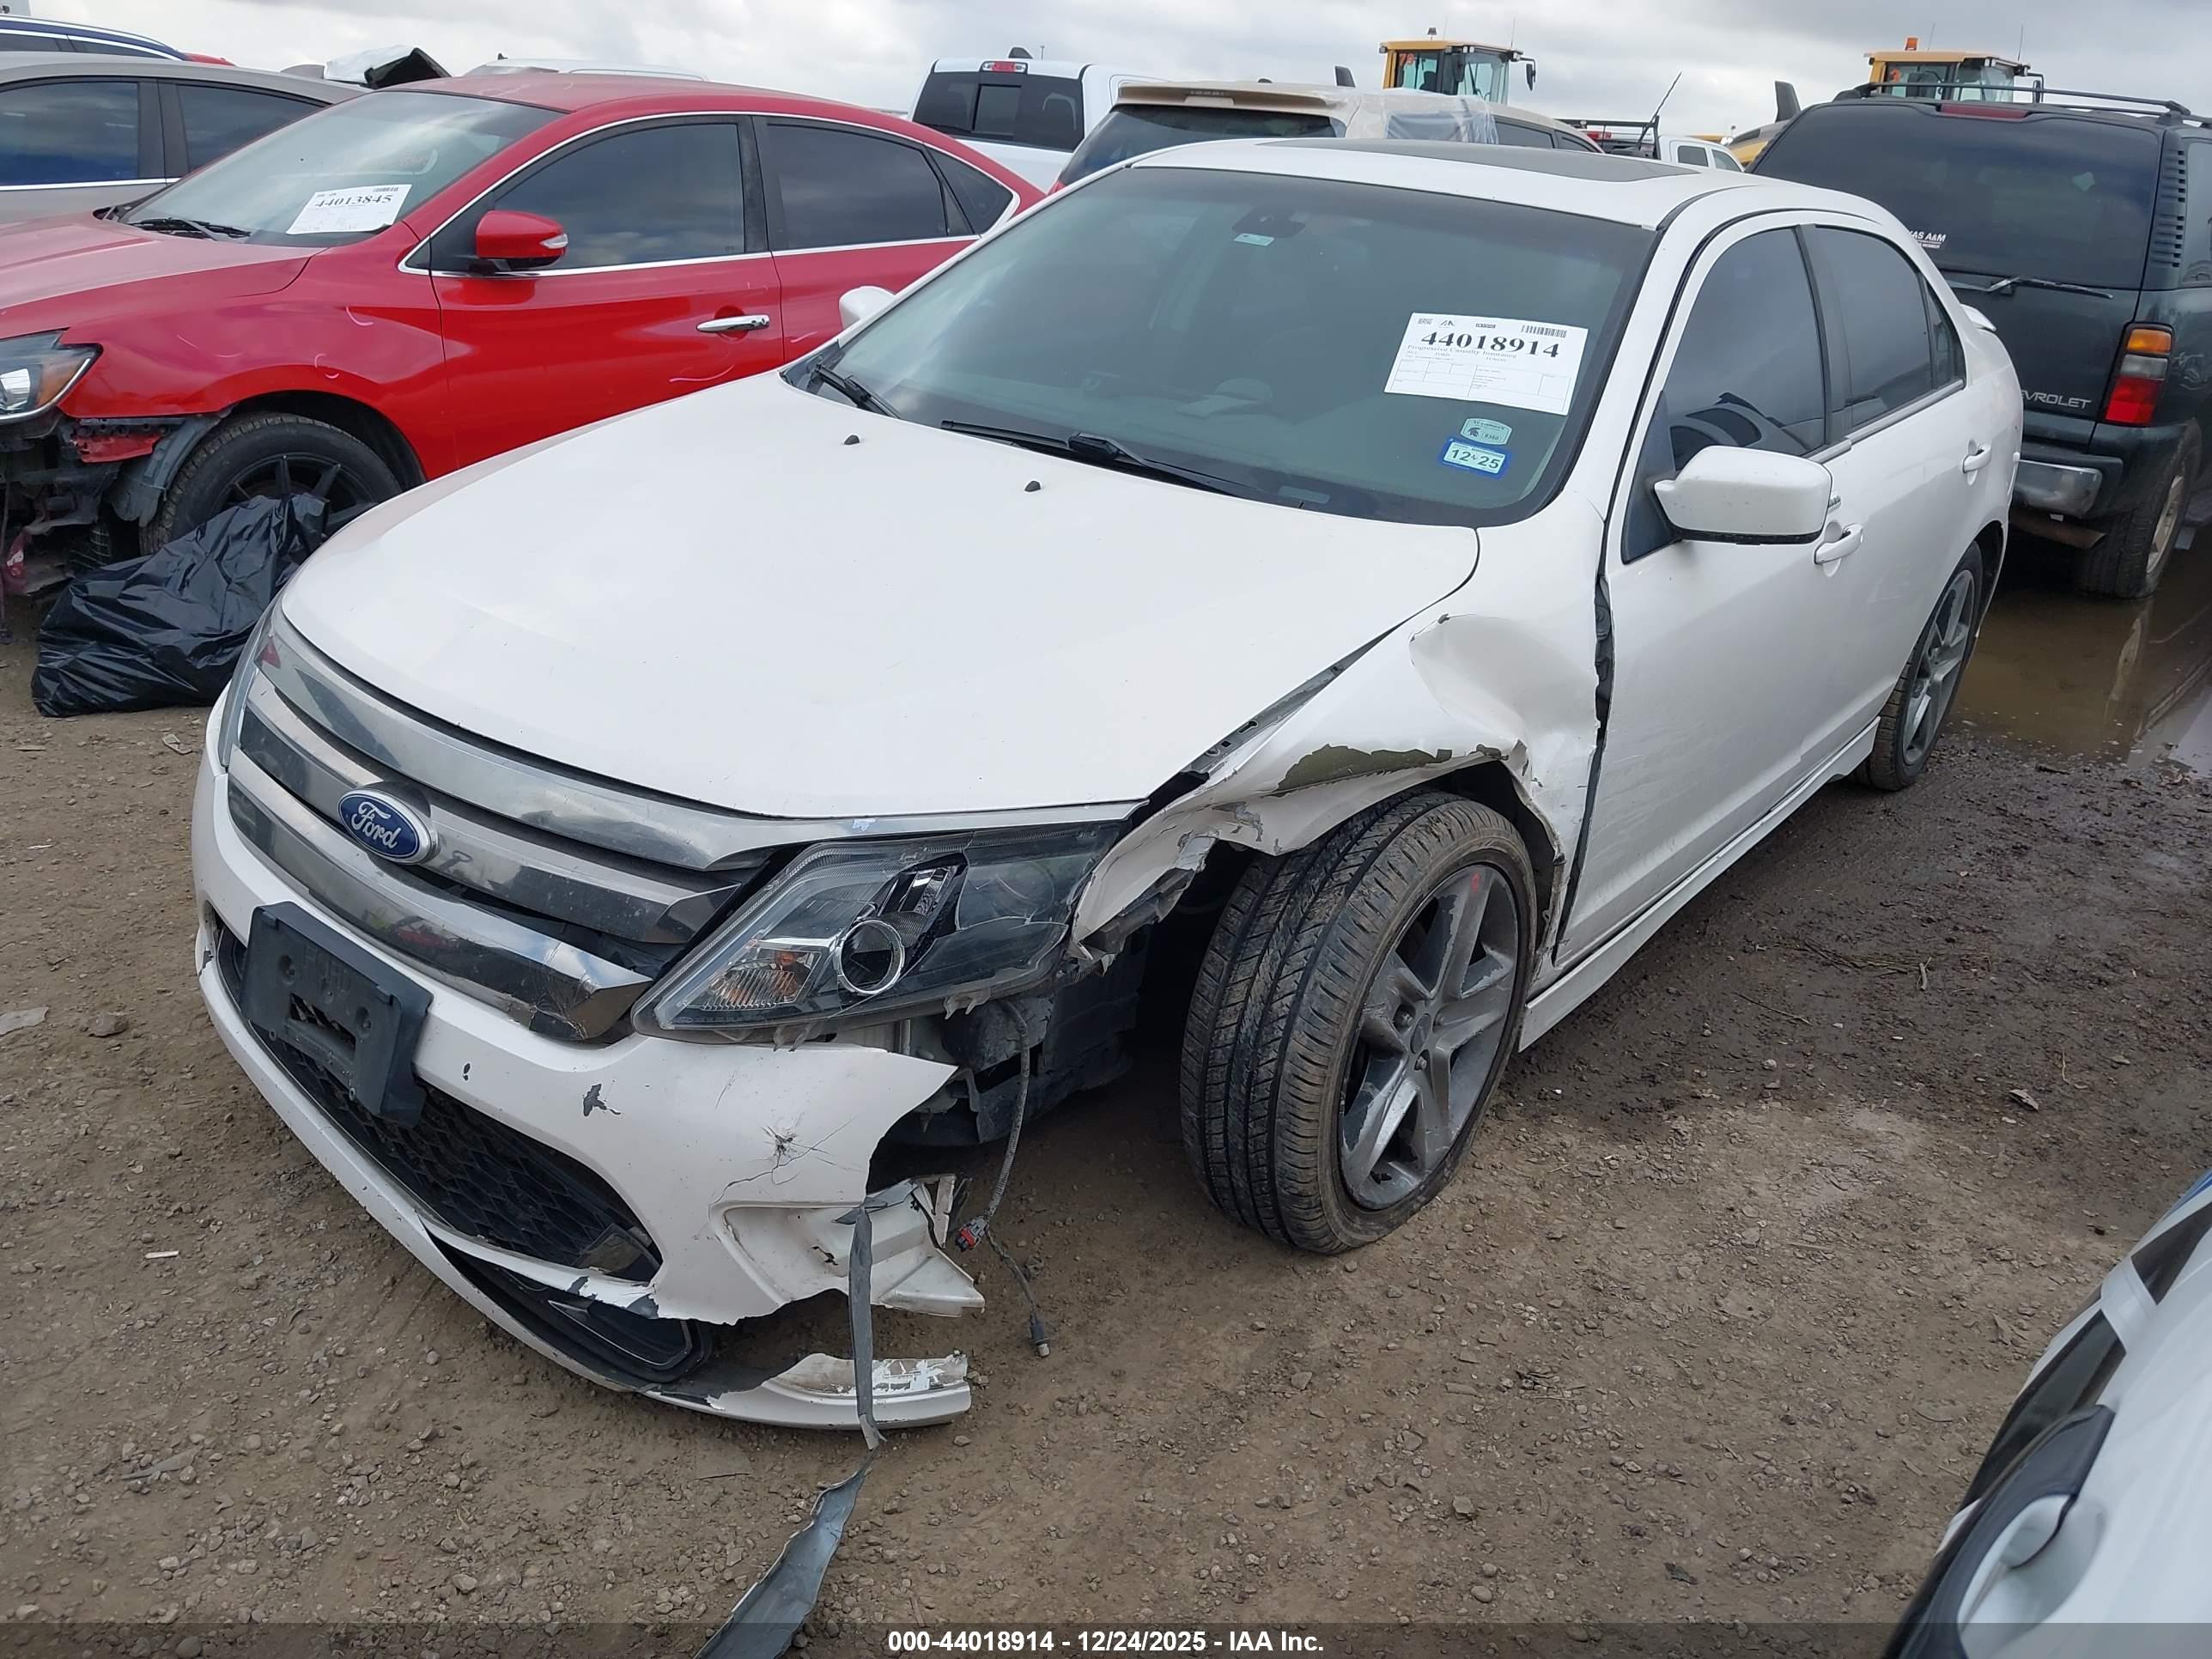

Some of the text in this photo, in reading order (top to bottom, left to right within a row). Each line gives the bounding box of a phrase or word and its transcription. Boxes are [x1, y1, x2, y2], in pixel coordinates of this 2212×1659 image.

[315, 194, 393, 208] 44013845
[1910, 230, 1947, 242] AS A&M
[1421, 331, 1559, 358] 44018914
[1451, 449, 1471, 462] 12
[1478, 456, 1501, 469] 25
[351, 801, 402, 848] Ford
